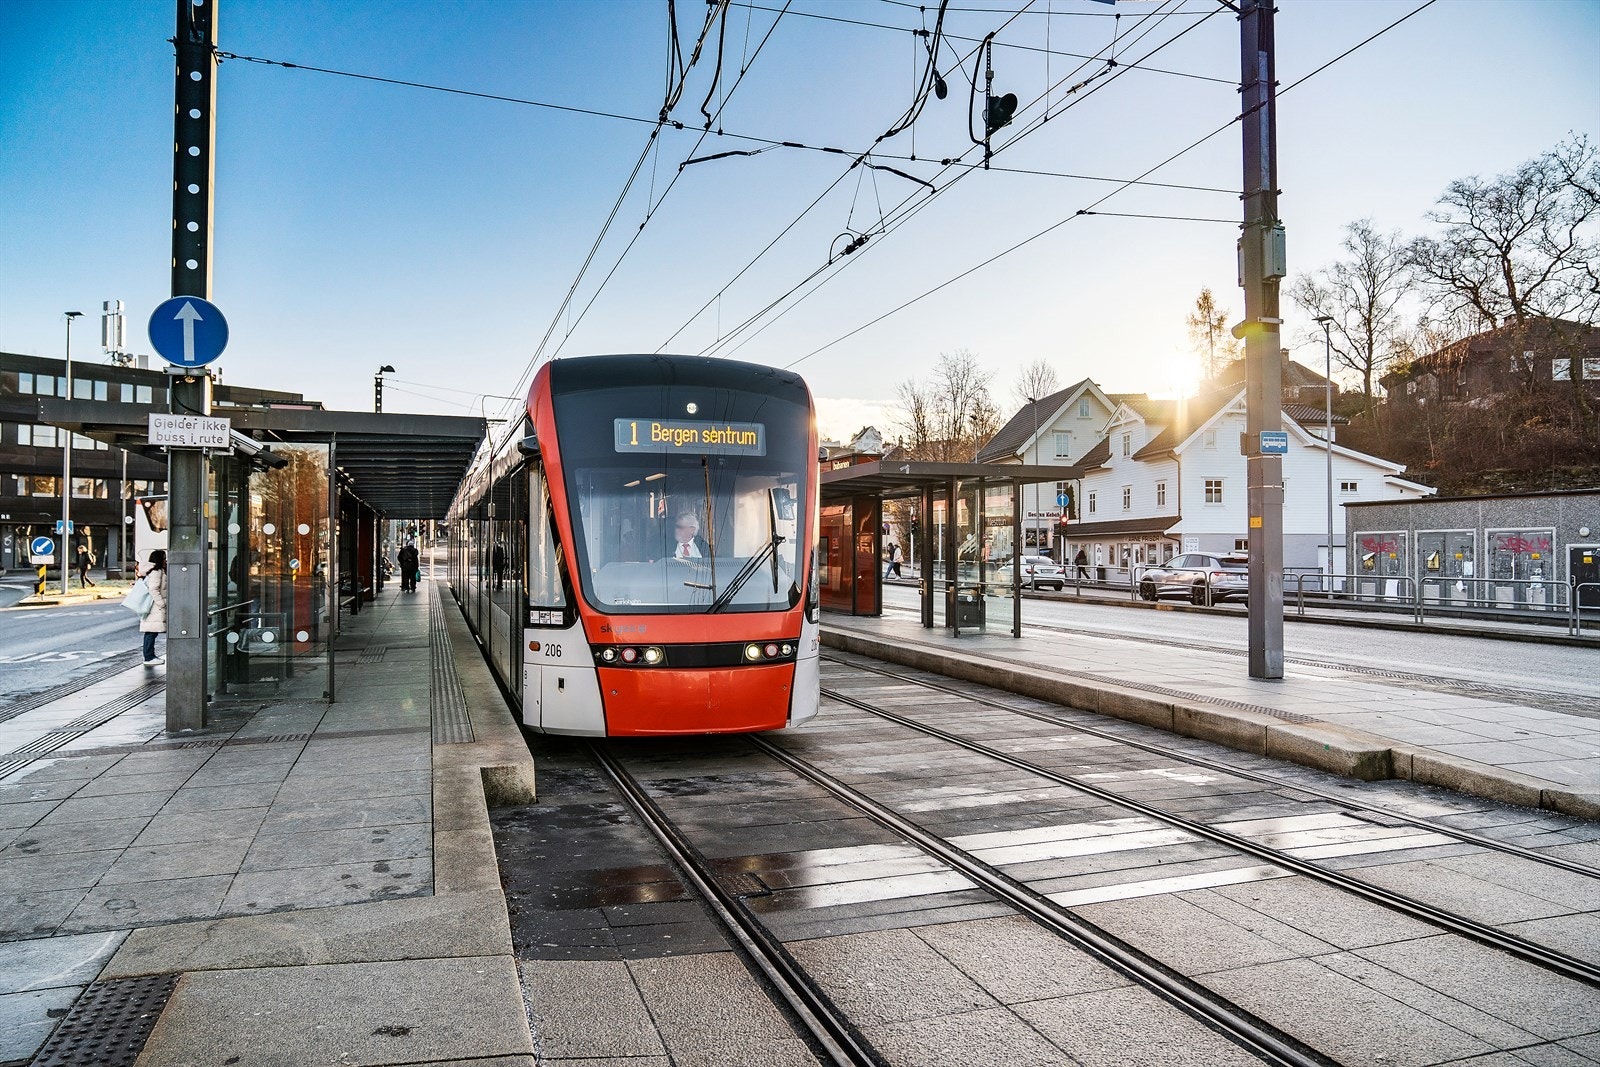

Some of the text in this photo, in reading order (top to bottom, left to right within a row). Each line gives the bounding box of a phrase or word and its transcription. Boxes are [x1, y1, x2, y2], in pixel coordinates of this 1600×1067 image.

[154, 418, 227, 431] Gjelder ikke
[156, 431, 223, 444] buss i rute
[630, 421, 757, 447] 1 Bergen sentrum
[545, 643, 562, 658] 206
